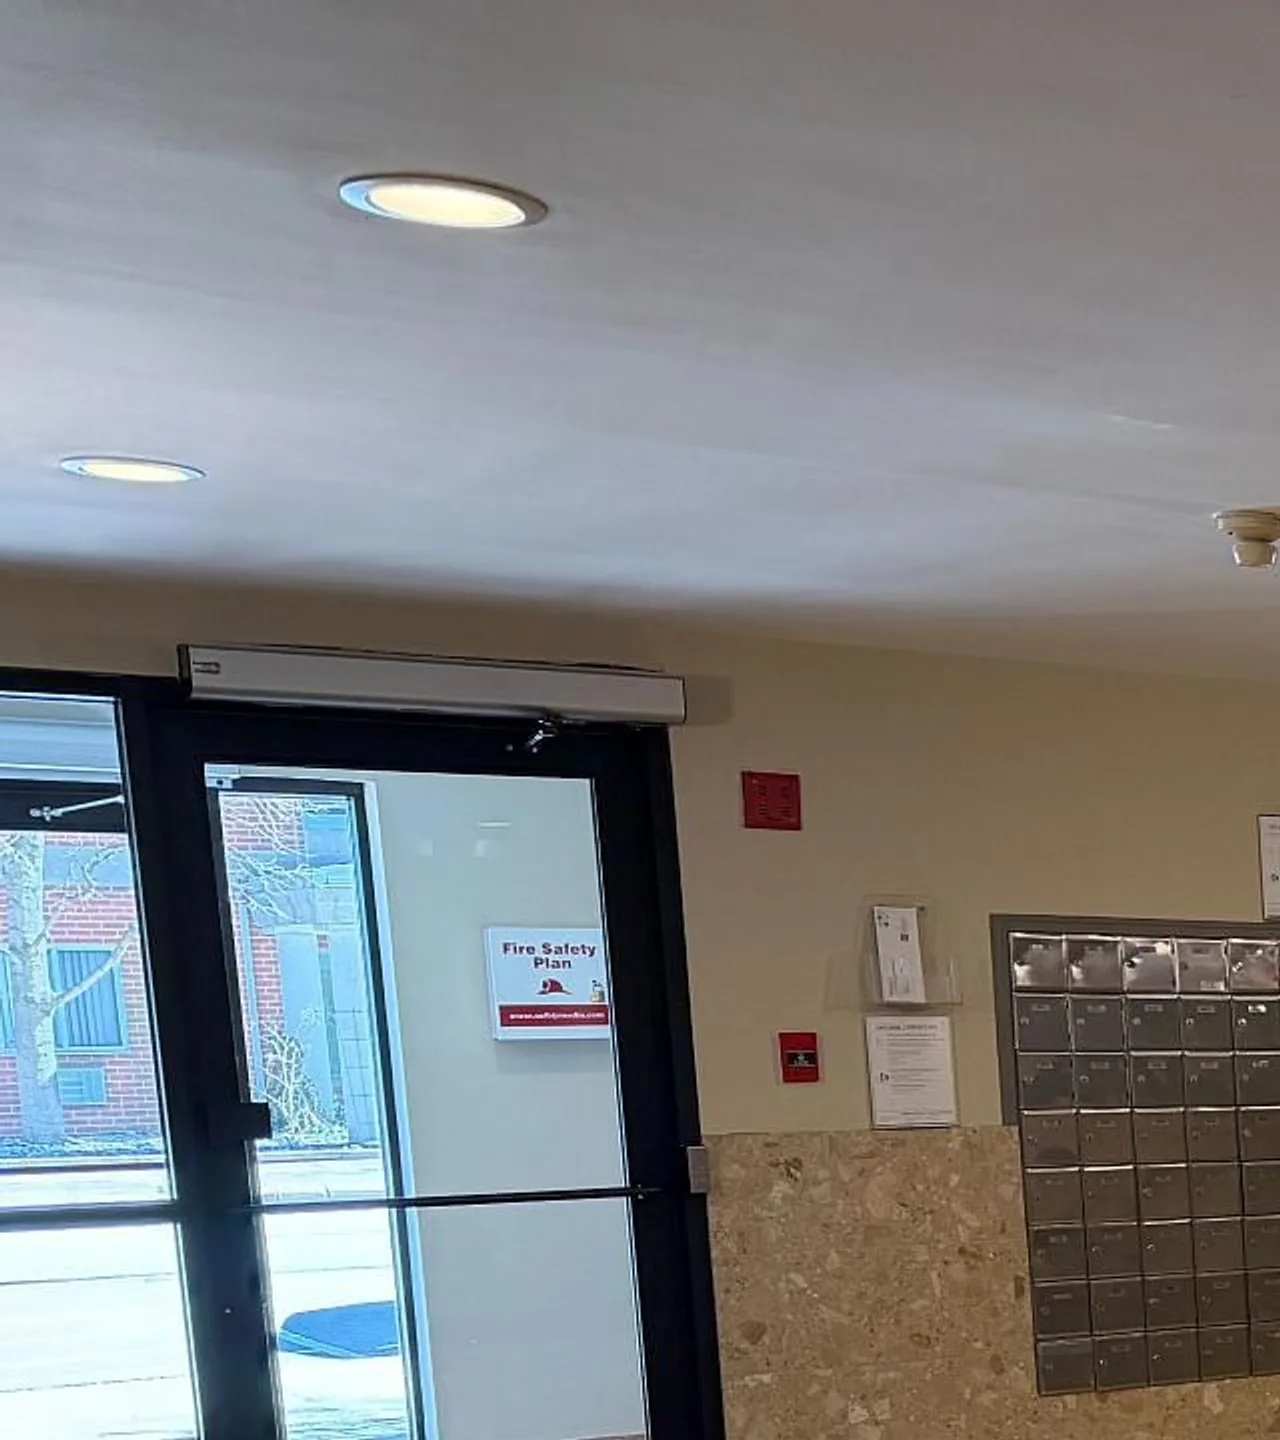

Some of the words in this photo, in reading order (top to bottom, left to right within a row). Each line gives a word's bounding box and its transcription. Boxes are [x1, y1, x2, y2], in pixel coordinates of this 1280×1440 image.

[502, 942, 535, 956] Fire
[542, 942, 596, 957] Safety
[534, 957, 572, 969] Plan
